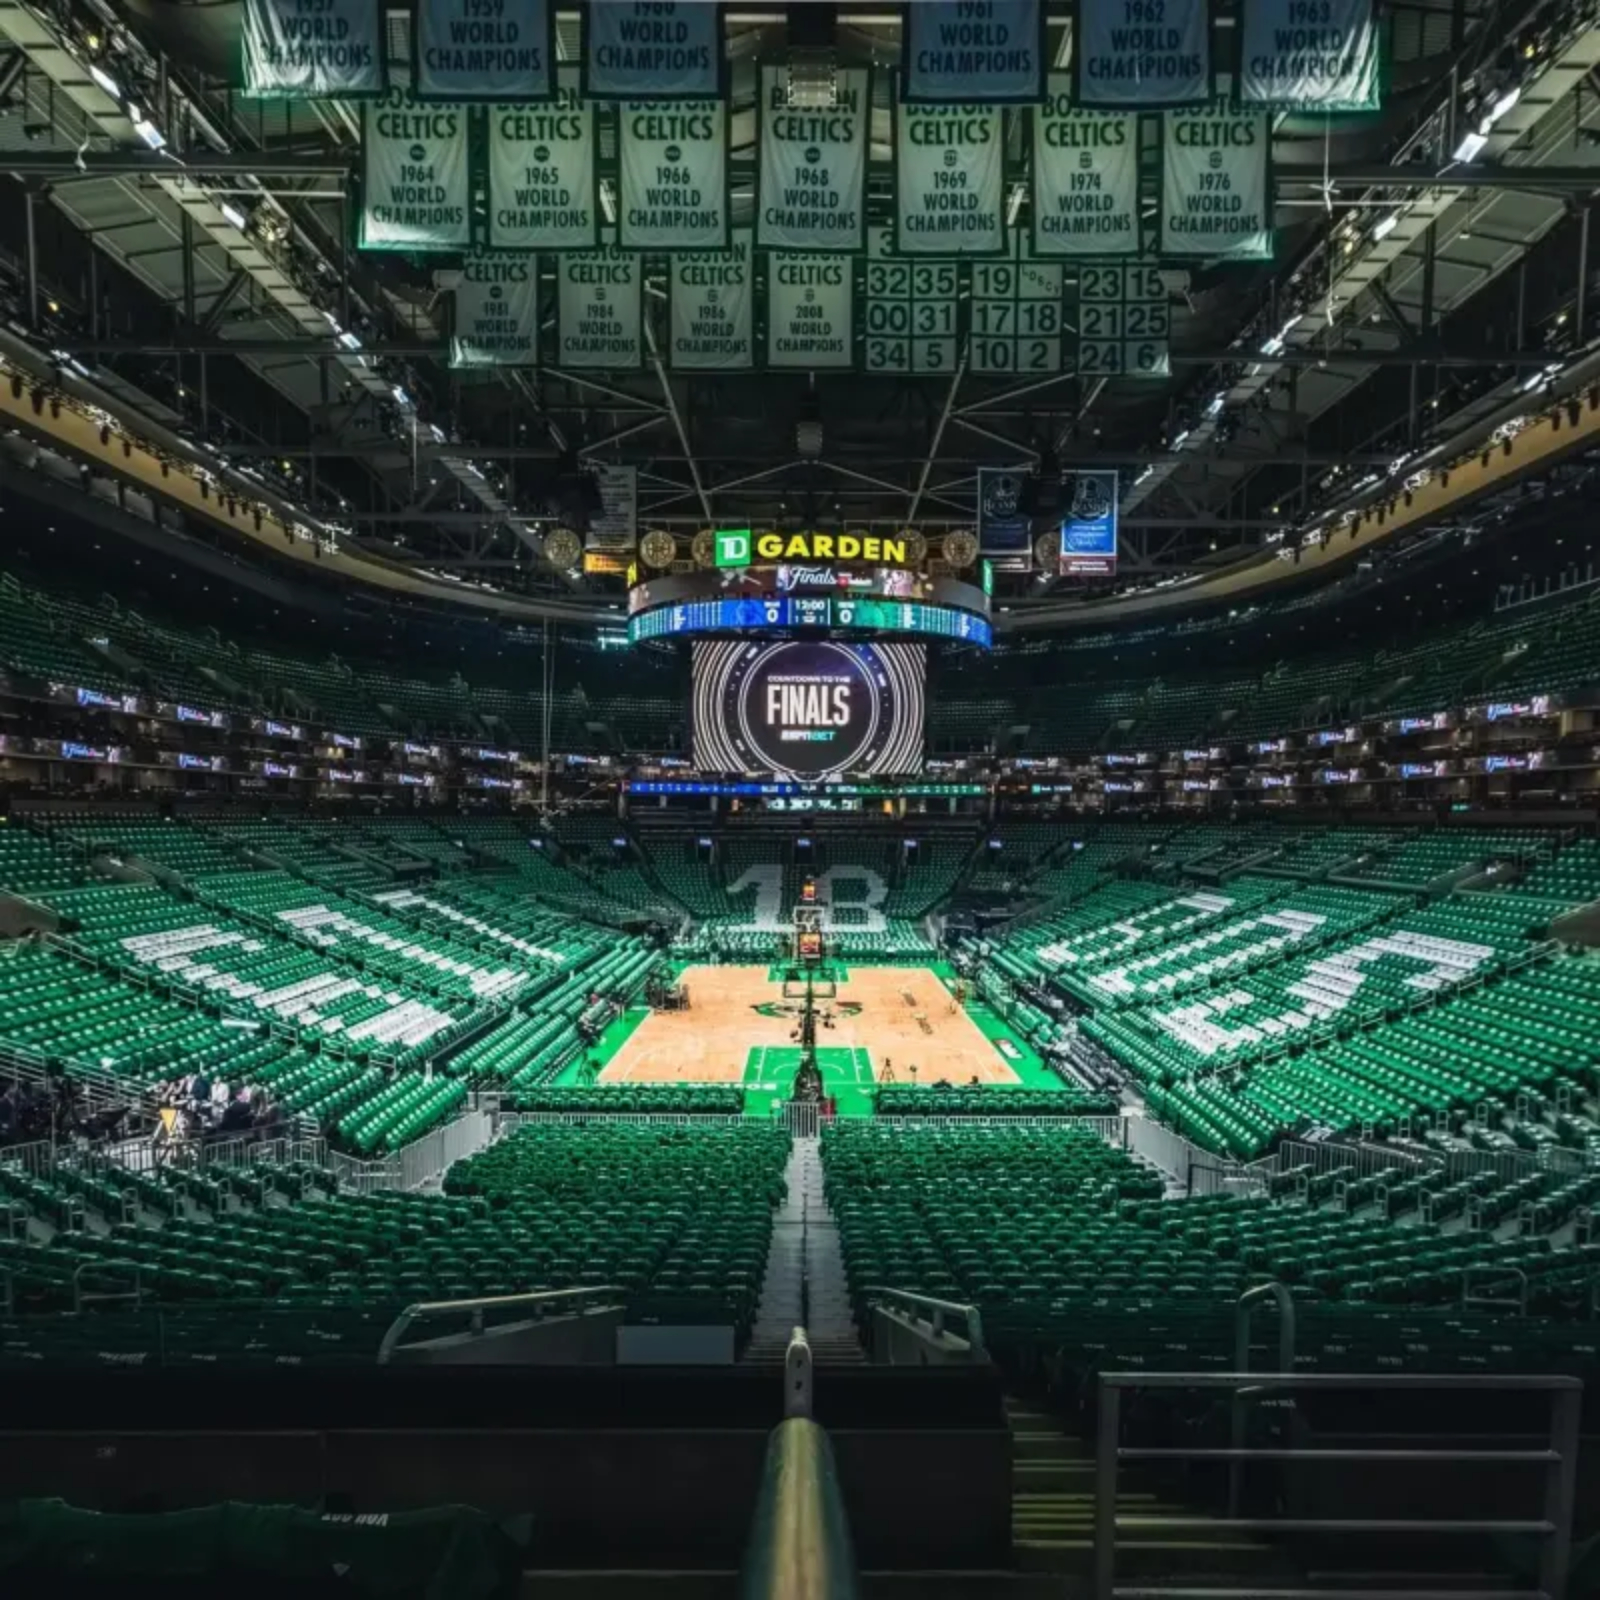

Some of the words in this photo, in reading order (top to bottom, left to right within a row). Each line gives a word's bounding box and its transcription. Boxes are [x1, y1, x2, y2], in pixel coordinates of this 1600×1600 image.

[957, 1, 993, 19] 1961
[1125, 0, 1165, 23] 1962
[1289, 1, 1330, 24] 1963
[280, 17, 348, 40] WORLD
[450, 22, 519, 44] WORLD
[620, 20, 688, 43] WORLD
[940, 23, 1009, 46] WORLD
[1111, 29, 1180, 51] WORLD
[1275, 29, 1343, 51] WORLD
[426, 48, 541, 72] CHAMPIONS
[597, 45, 710, 70] CHAMPIONS
[918, 50, 1031, 74] CHAMPIONS
[1089, 55, 1200, 80] CHAMPIONS
[377, 113, 457, 140] CELTICS
[501, 115, 582, 141] CELTICS
[632, 115, 713, 141] CELTICS
[772, 116, 853, 143] CELTICS
[910, 119, 990, 145] CELTICS
[1045, 121, 1125, 147] CELTICS
[1175, 121, 1255, 147] CELTICS
[400, 165, 434, 183] 1964
[526, 167, 559, 184] 1965
[656, 167, 690, 184] 1966
[795, 168, 829, 186] 1968
[934, 171, 967, 189] 1969
[1070, 173, 1101, 191] 1974
[1199, 173, 1230, 191] 1976
[390, 186, 446, 203] WORLD
[515, 189, 570, 206] WORLD
[646, 189, 701, 206] WORLD
[784, 189, 839, 207] WORLD
[923, 194, 978, 211] WORLD
[1058, 195, 1113, 212] WORLD
[1187, 195, 1241, 212] WORLD
[373, 205, 463, 225] CHAMPIONS
[498, 209, 588, 228] CHAMPIONS
[628, 210, 719, 228] CHAMPIONS
[765, 208, 856, 230] CHAMPIONS
[906, 213, 995, 232] CHAMPIONS
[1041, 214, 1130, 234] CHAMPIONS
[1169, 216, 1258, 234] CHAMPIONS
[464, 262, 528, 282] CELTICS
[568, 264, 631, 284] CELTICS
[680, 265, 744, 286] CELTICS
[778, 265, 842, 285] CELTICS
[870, 266, 907, 294] 32
[915, 267, 954, 294] 35
[978, 267, 1011, 294] 19
[1082, 269, 1119, 297] 23
[1131, 269, 1164, 297] 15
[587, 304, 614, 318] 1984
[870, 304, 907, 331] 00
[919, 304, 951, 332] 31
[976, 304, 1010, 332] 17
[1024, 304, 1056, 332] 18
[1084, 307, 1117, 334] 21
[1128, 306, 1166, 333] 25
[474, 320, 518, 333] WORLD
[579, 322, 622, 336] WORLD
[691, 322, 734, 336] WORLD
[790, 322, 832, 335] WORLD
[564, 337, 636, 353] CHAMPIONS
[676, 338, 747, 353] CHAMPIONS
[776, 338, 844, 352] CHAMPIONS
[870, 340, 906, 368] 34
[925, 343, 943, 368] 5
[976, 341, 1009, 368] 10
[1030, 342, 1048, 369] 2
[1081, 344, 1120, 371] 24
[1138, 344, 1155, 370] 6
[719, 536, 747, 560] TD
[757, 534, 905, 562] GARDEN
[787, 567, 838, 591] Finals
[795, 600, 825, 610] 12:00
[767, 609, 778, 623] 0
[839, 609, 852, 623] 0
[767, 685, 850, 726] FINALS
